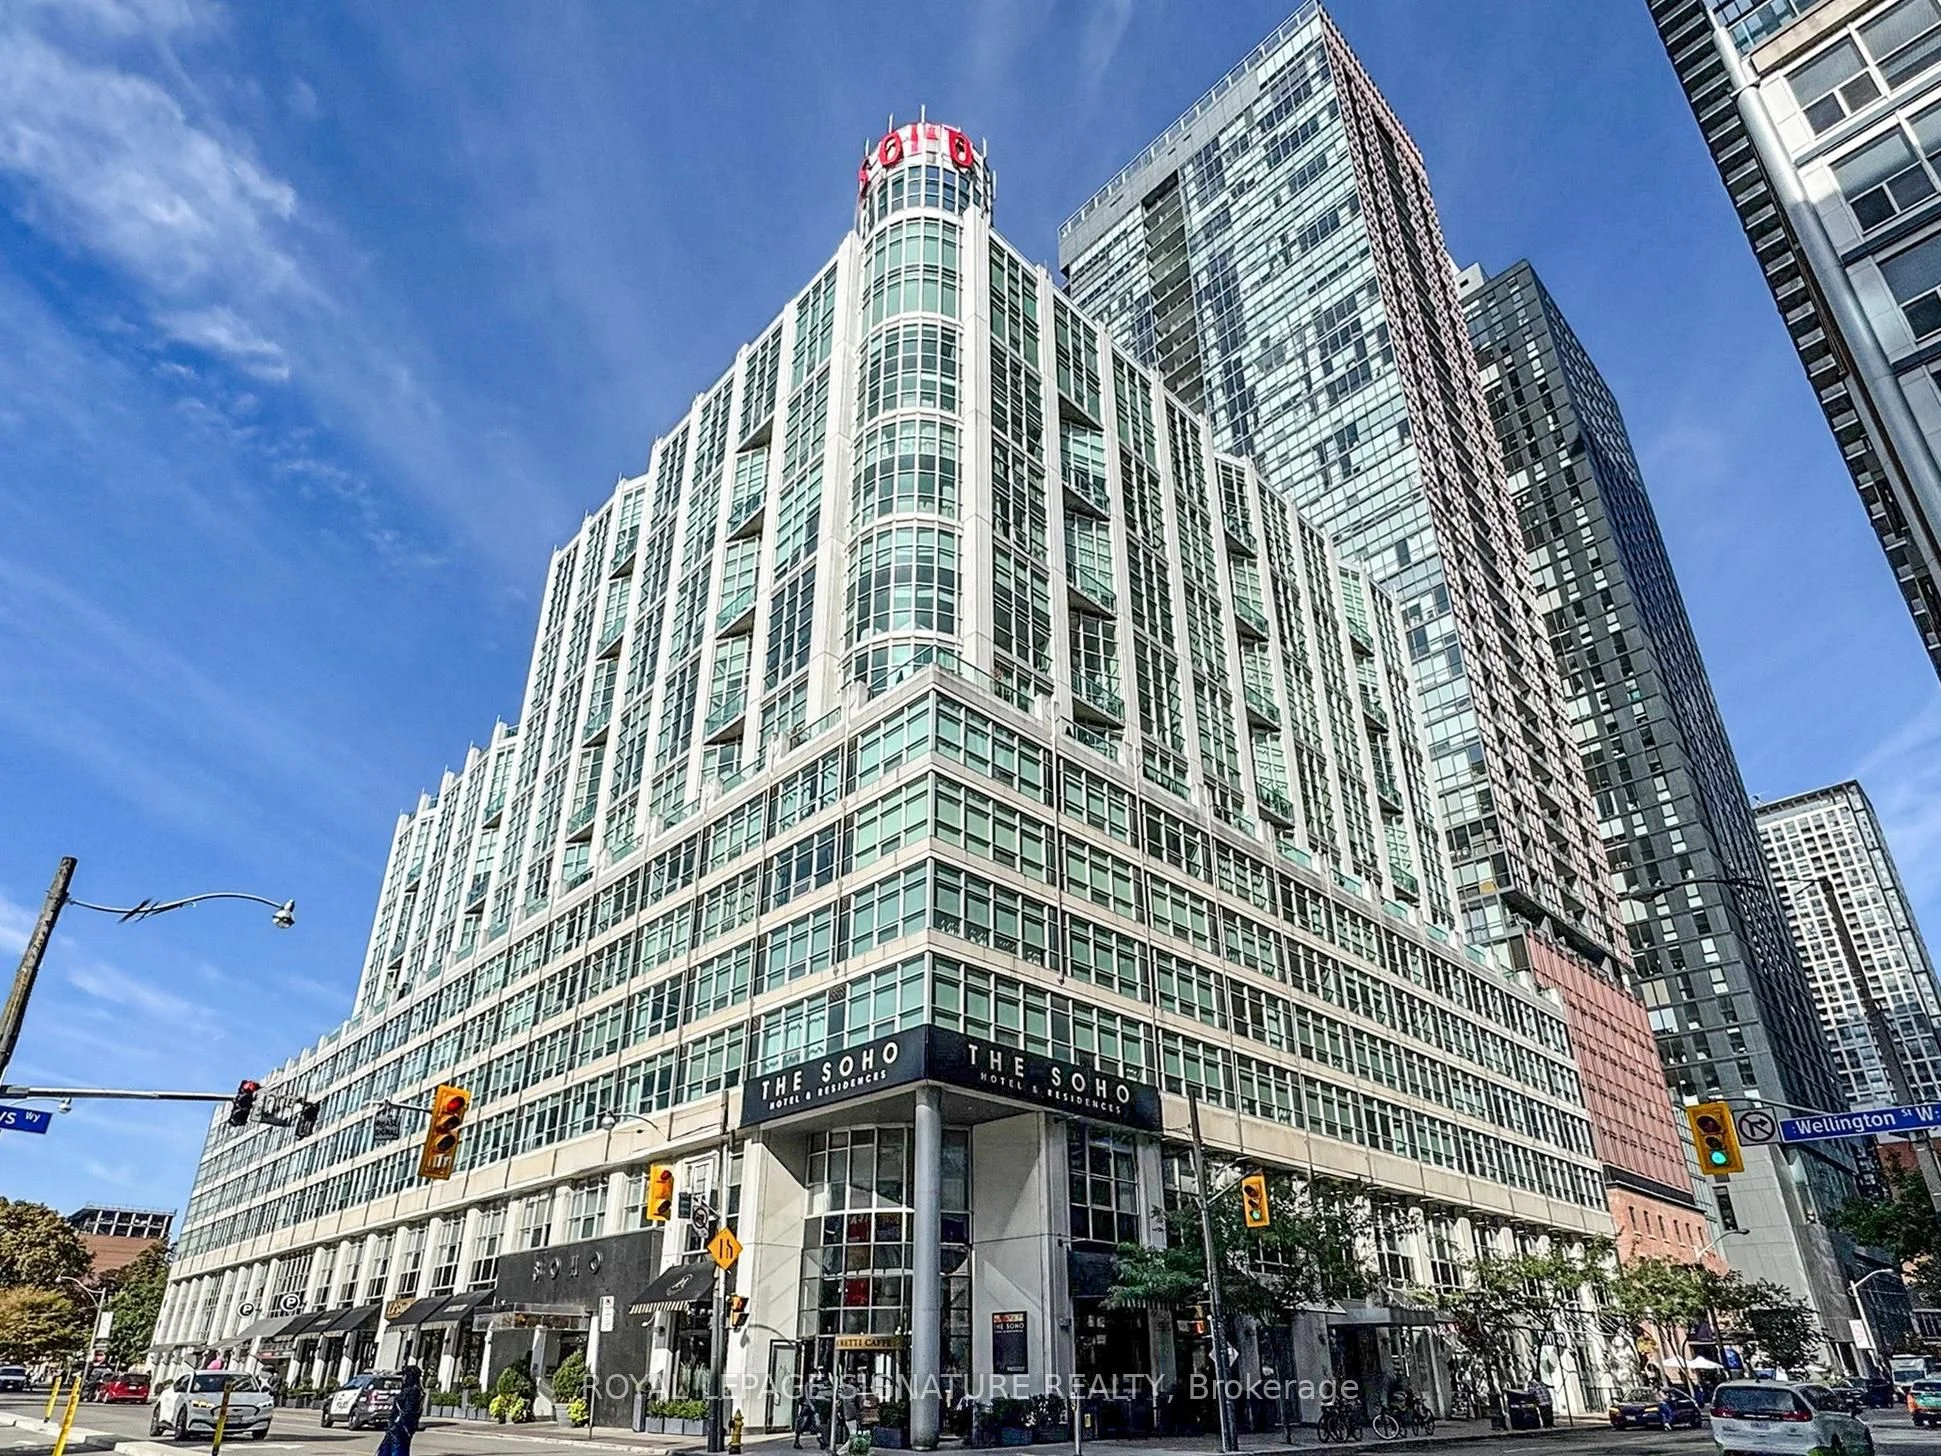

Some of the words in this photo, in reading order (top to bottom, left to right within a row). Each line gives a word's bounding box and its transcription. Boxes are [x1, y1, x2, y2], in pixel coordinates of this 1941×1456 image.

[761, 1070, 803, 1101] THE
[821, 1041, 899, 1083] SOHO
[769, 1096, 800, 1110] HOTEL
[817, 1069, 887, 1097] RESIDENCES
[968, 1043, 1024, 1079] THE
[1051, 1066, 1130, 1104] SOHO
[980, 1071, 1023, 1091] HOTEL
[1047, 1089, 1121, 1115] RESIDENCES
[25, 1111, 41, 1123] Wy
[1795, 1112, 1896, 1135] Wellington
[1901, 1108, 1912, 1118] St
